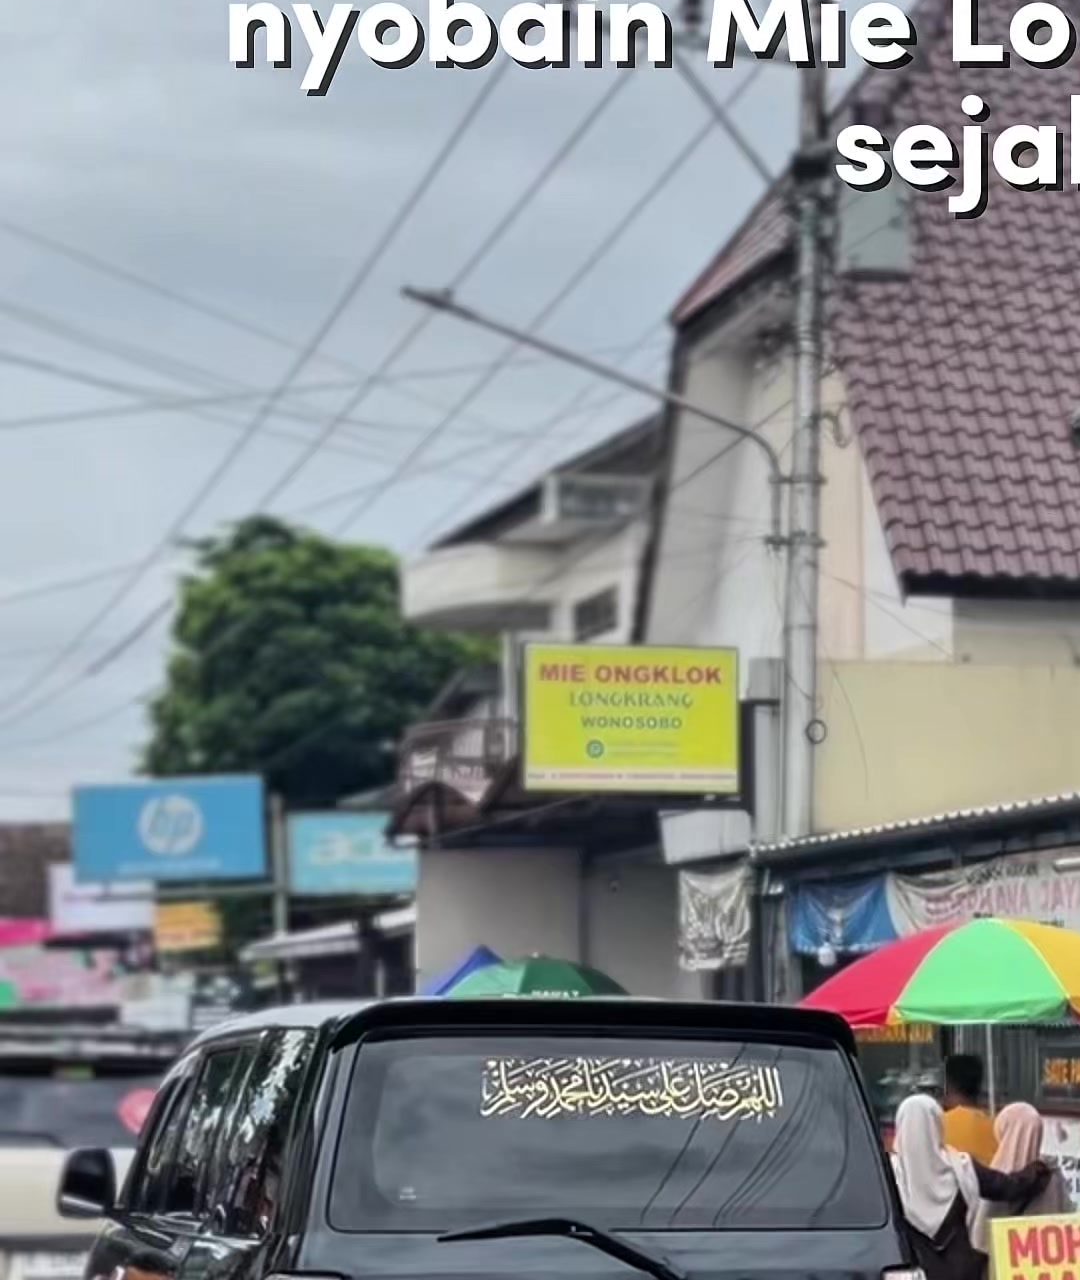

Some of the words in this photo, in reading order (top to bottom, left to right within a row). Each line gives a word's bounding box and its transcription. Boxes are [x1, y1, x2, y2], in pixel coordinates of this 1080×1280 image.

[539, 663, 586, 683] MIE
[593, 665, 723, 685] ONGKLOK
[569, 690, 694, 710] LONGKRANG
[580, 715, 684, 731] WONOSOBO
